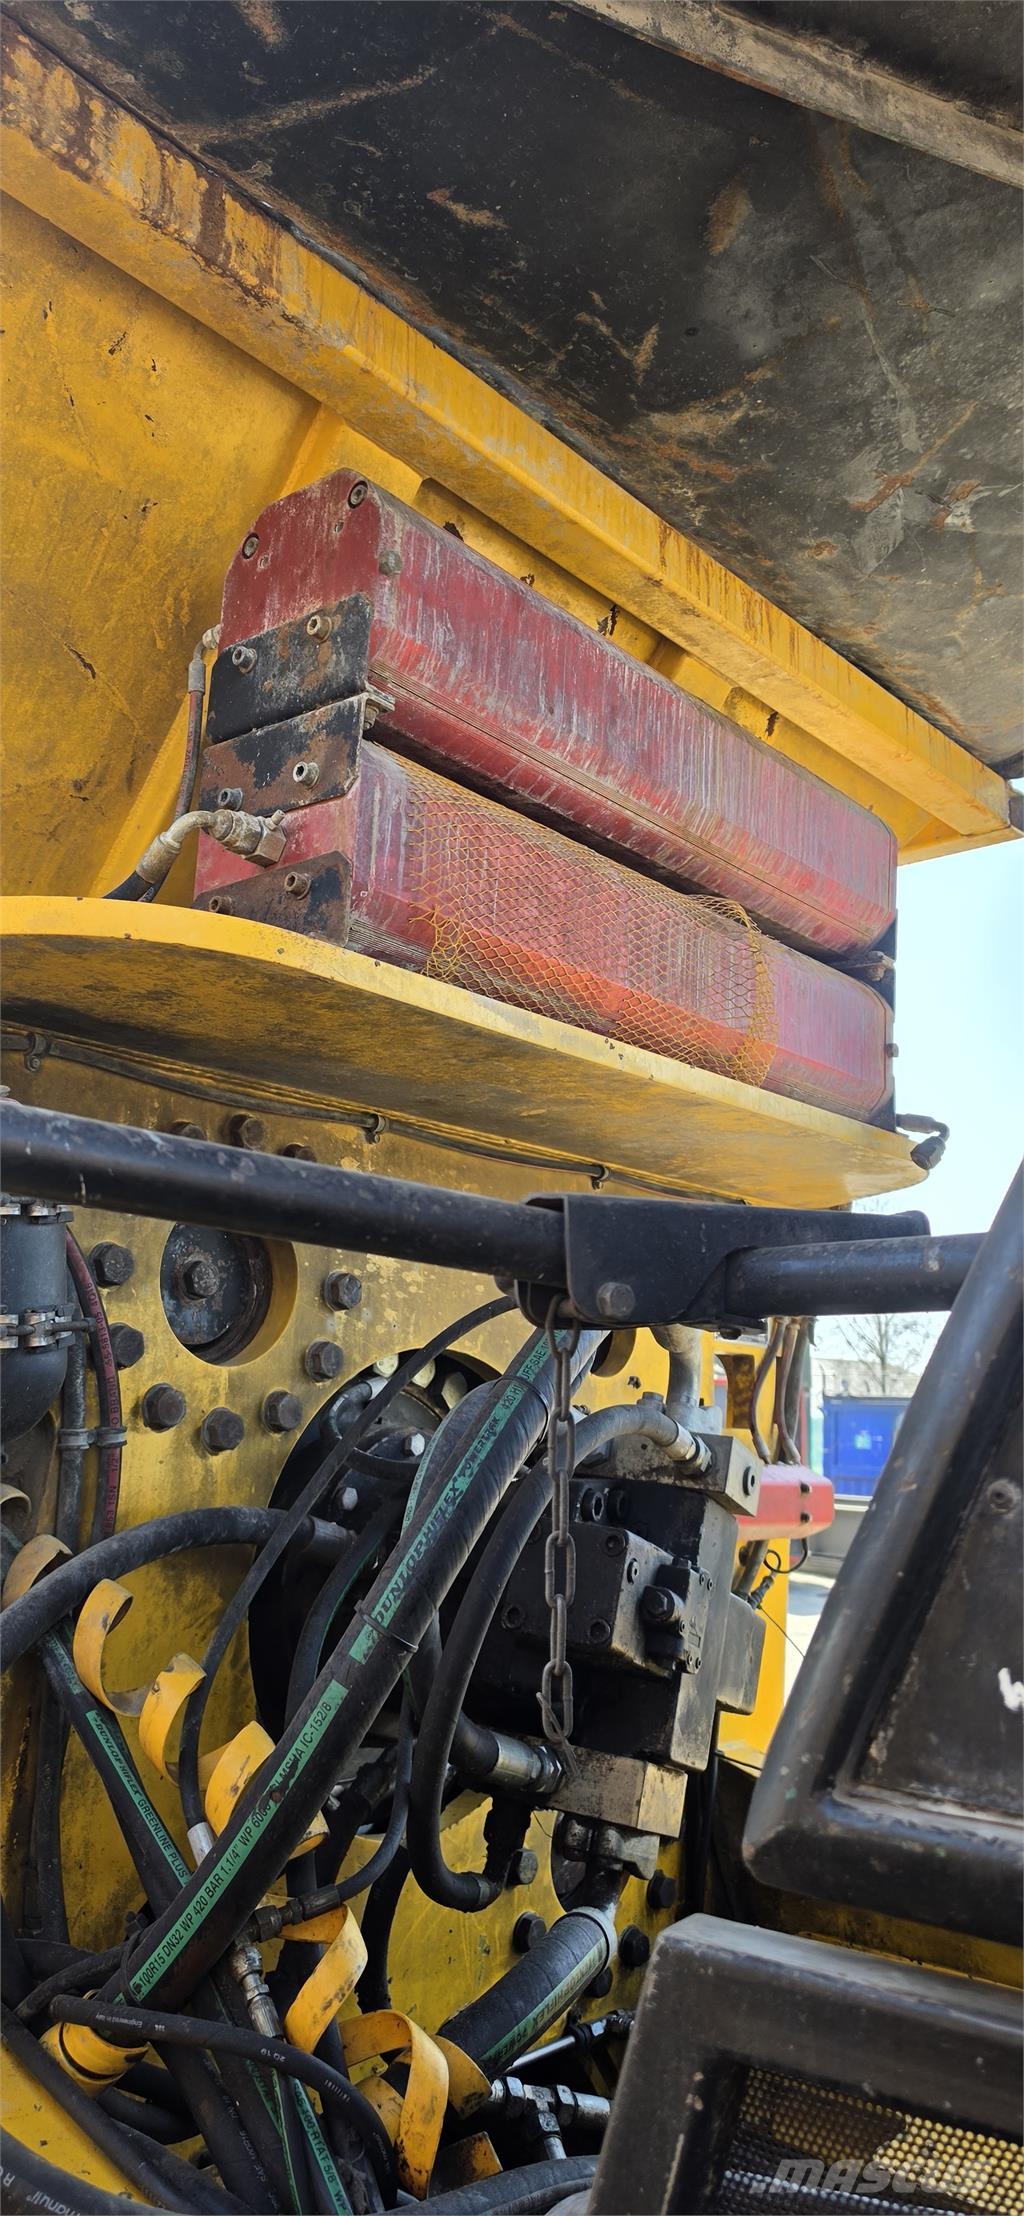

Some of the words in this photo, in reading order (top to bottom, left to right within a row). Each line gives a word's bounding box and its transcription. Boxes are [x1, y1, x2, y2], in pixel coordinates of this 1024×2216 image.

[372, 1541, 424, 1623] DUNLOP
[499, 1392, 516, 1410] 420
[529, 1347, 546, 1366] SAE
[93, 1722, 124, 1766] DUNLOP
[118, 1764, 141, 1796] HIFLEX
[137, 1798, 172, 1851] GREENLINE
[167, 1851, 188, 1878] PLUS
[136, 1951, 168, 1988] 100R15
[159, 1928, 184, 1957] DN32
[177, 1912, 197, 1932] WP
[190, 1895, 210, 1916] 420
[202, 1873, 225, 1899] BAR
[237, 1825, 257, 1846] WP
[296, 1701, 335, 1748] IC-152/8
